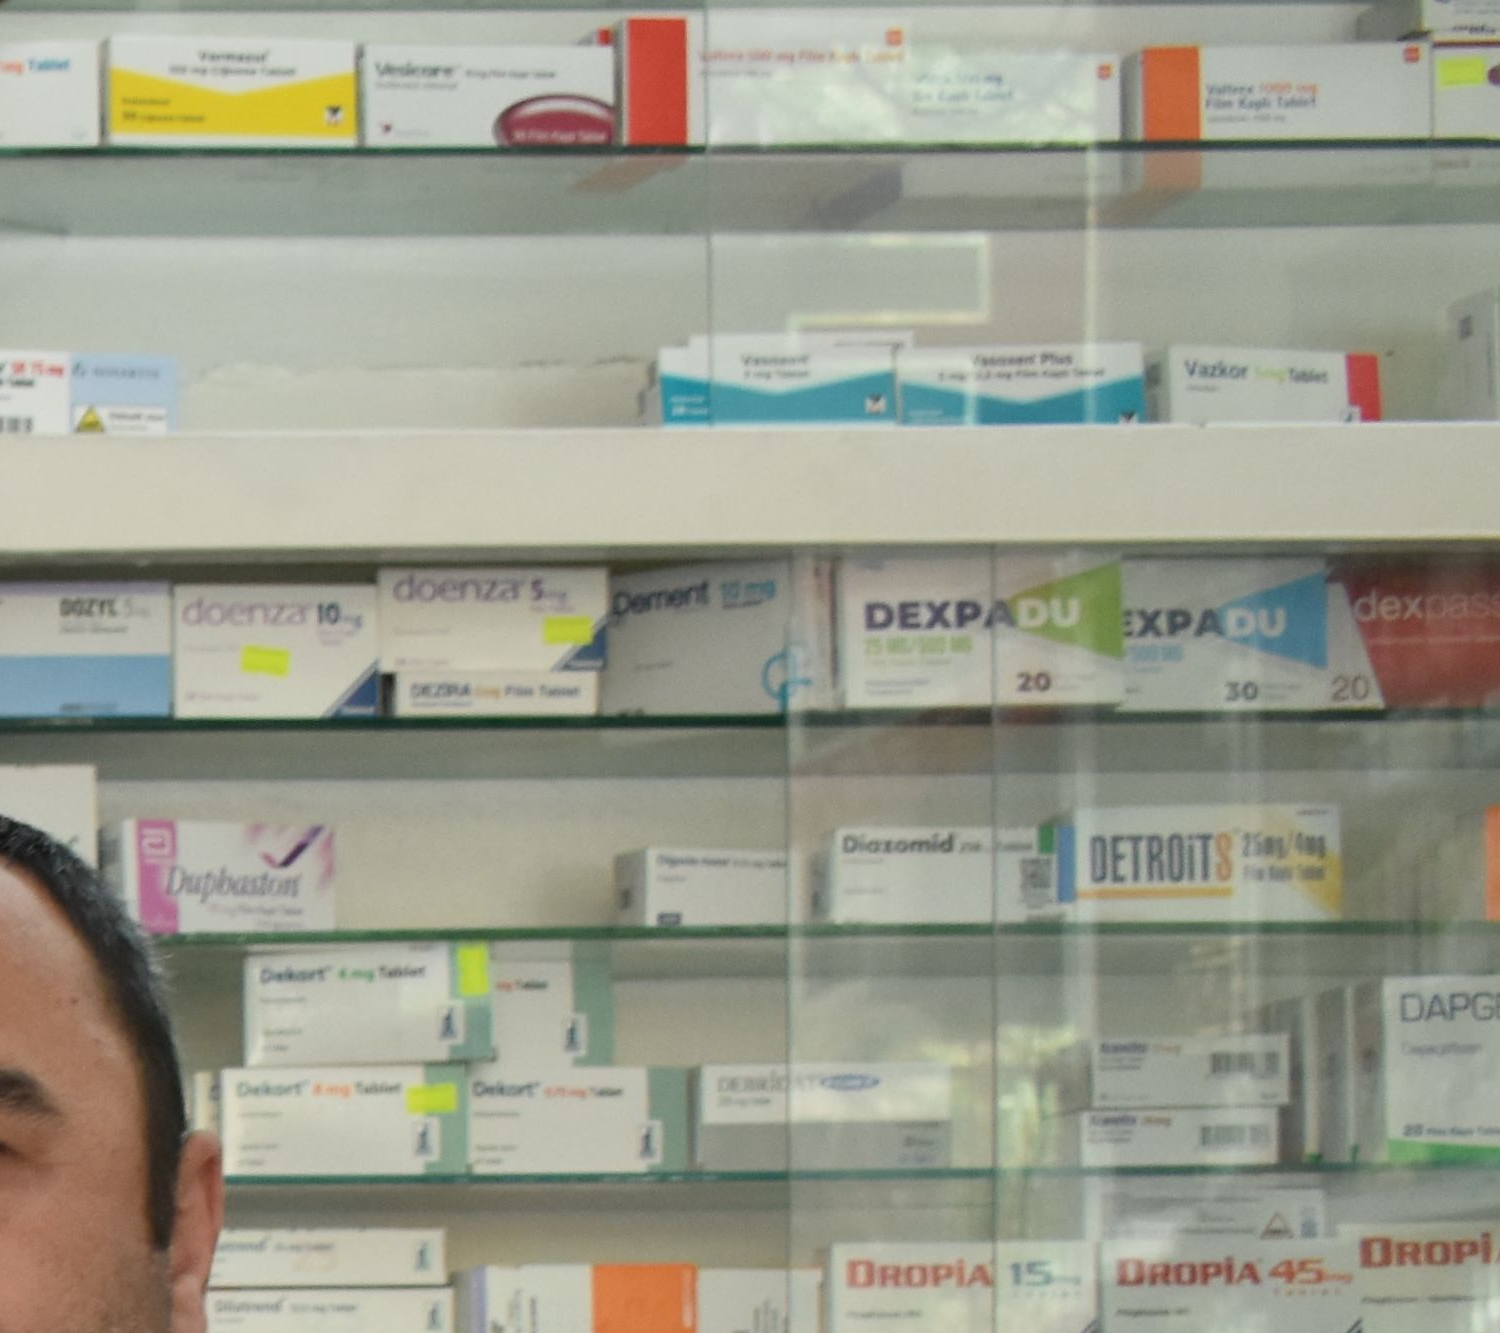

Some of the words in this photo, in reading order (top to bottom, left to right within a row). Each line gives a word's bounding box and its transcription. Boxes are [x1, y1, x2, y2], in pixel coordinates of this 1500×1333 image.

[1184, 359, 1248, 380] Vazkor
[393, 576, 520, 603] doenza
[865, 597, 1081, 632] DEXPADU
[1122, 606, 1287, 639] EXPADU
[1016, 672, 1052, 692] 20
[1226, 681, 1258, 701] 30
[842, 834, 954, 856] Diazomid
[164, 865, 301, 910] Duphaston
[1360, 1232, 1500, 1269] DROPİ
